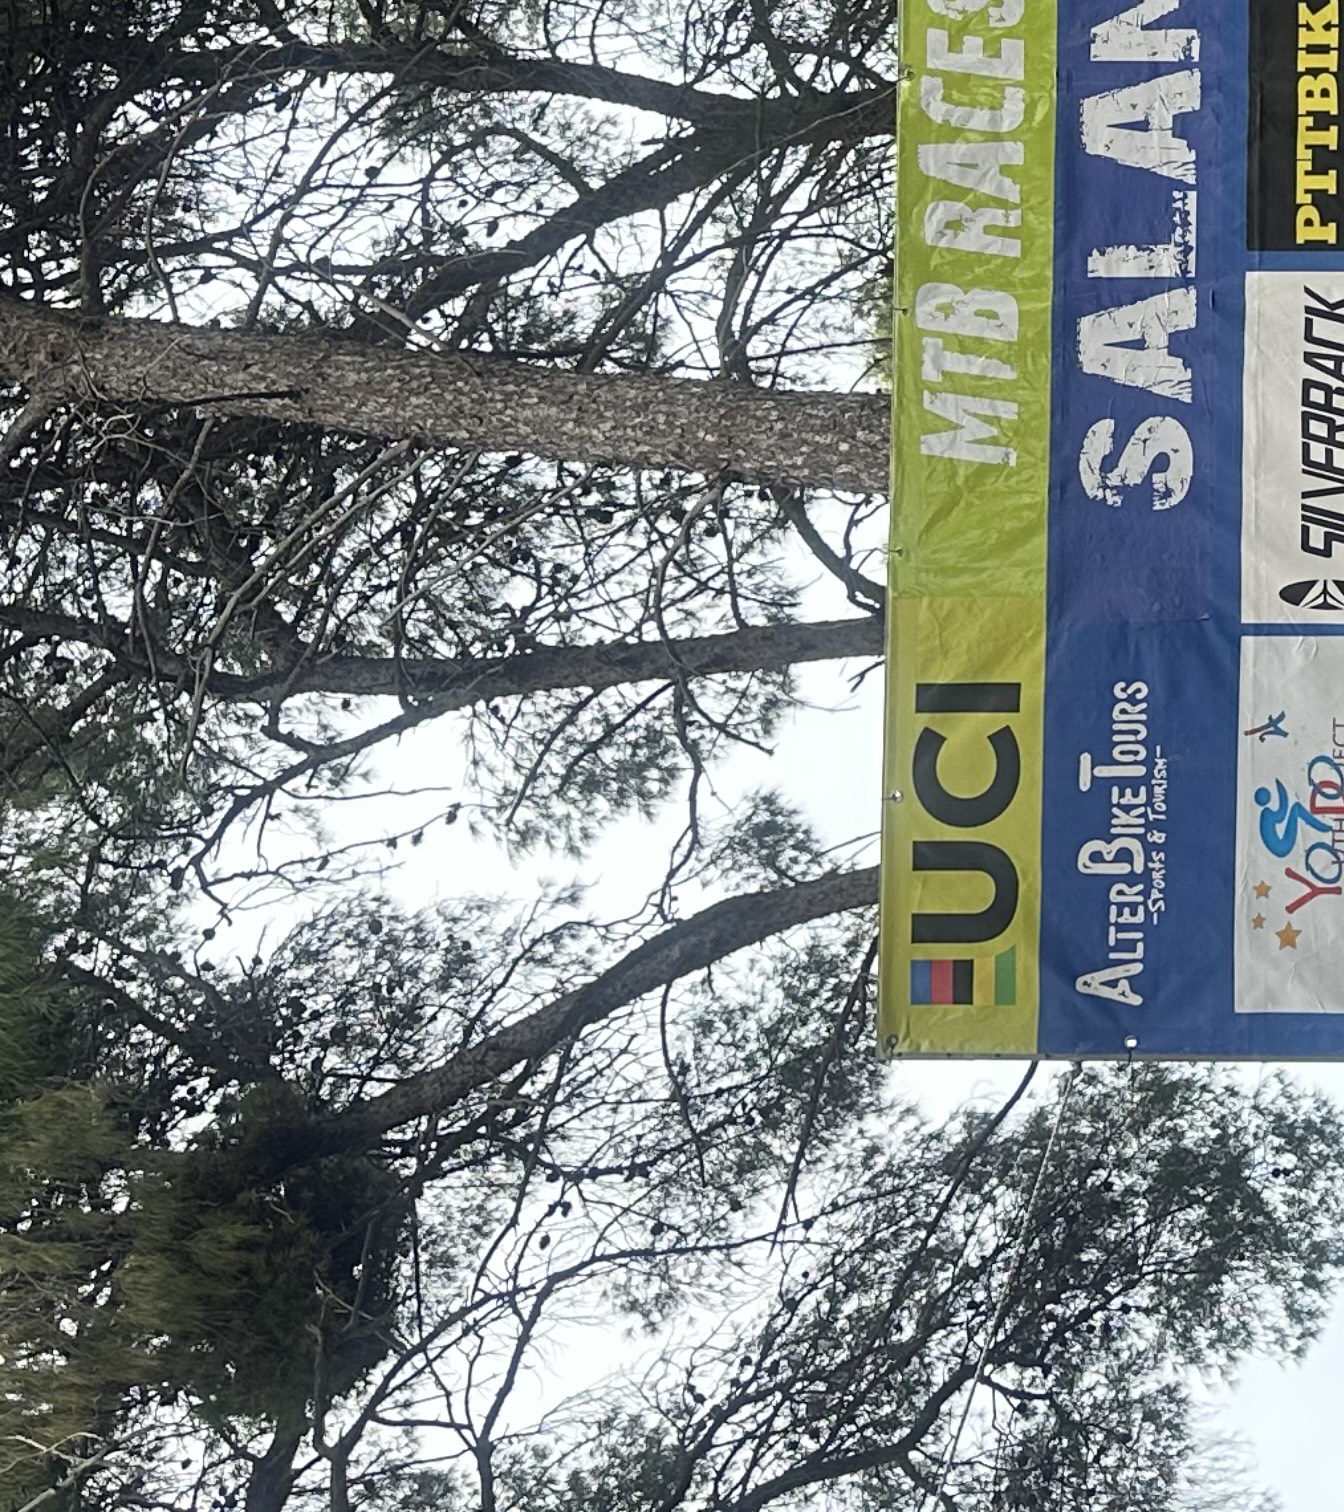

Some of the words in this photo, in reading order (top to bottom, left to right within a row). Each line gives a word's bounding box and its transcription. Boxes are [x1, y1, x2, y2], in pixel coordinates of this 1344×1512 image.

[915, 281, 1019, 466] MTB
[1078, 681, 1149, 792] TOURS
[911, 682, 1021, 944] UCI
[1076, 785, 1147, 875] BIKE
[1147, 832, 1166, 843] &
[1075, 883, 1144, 1006] ALTER
